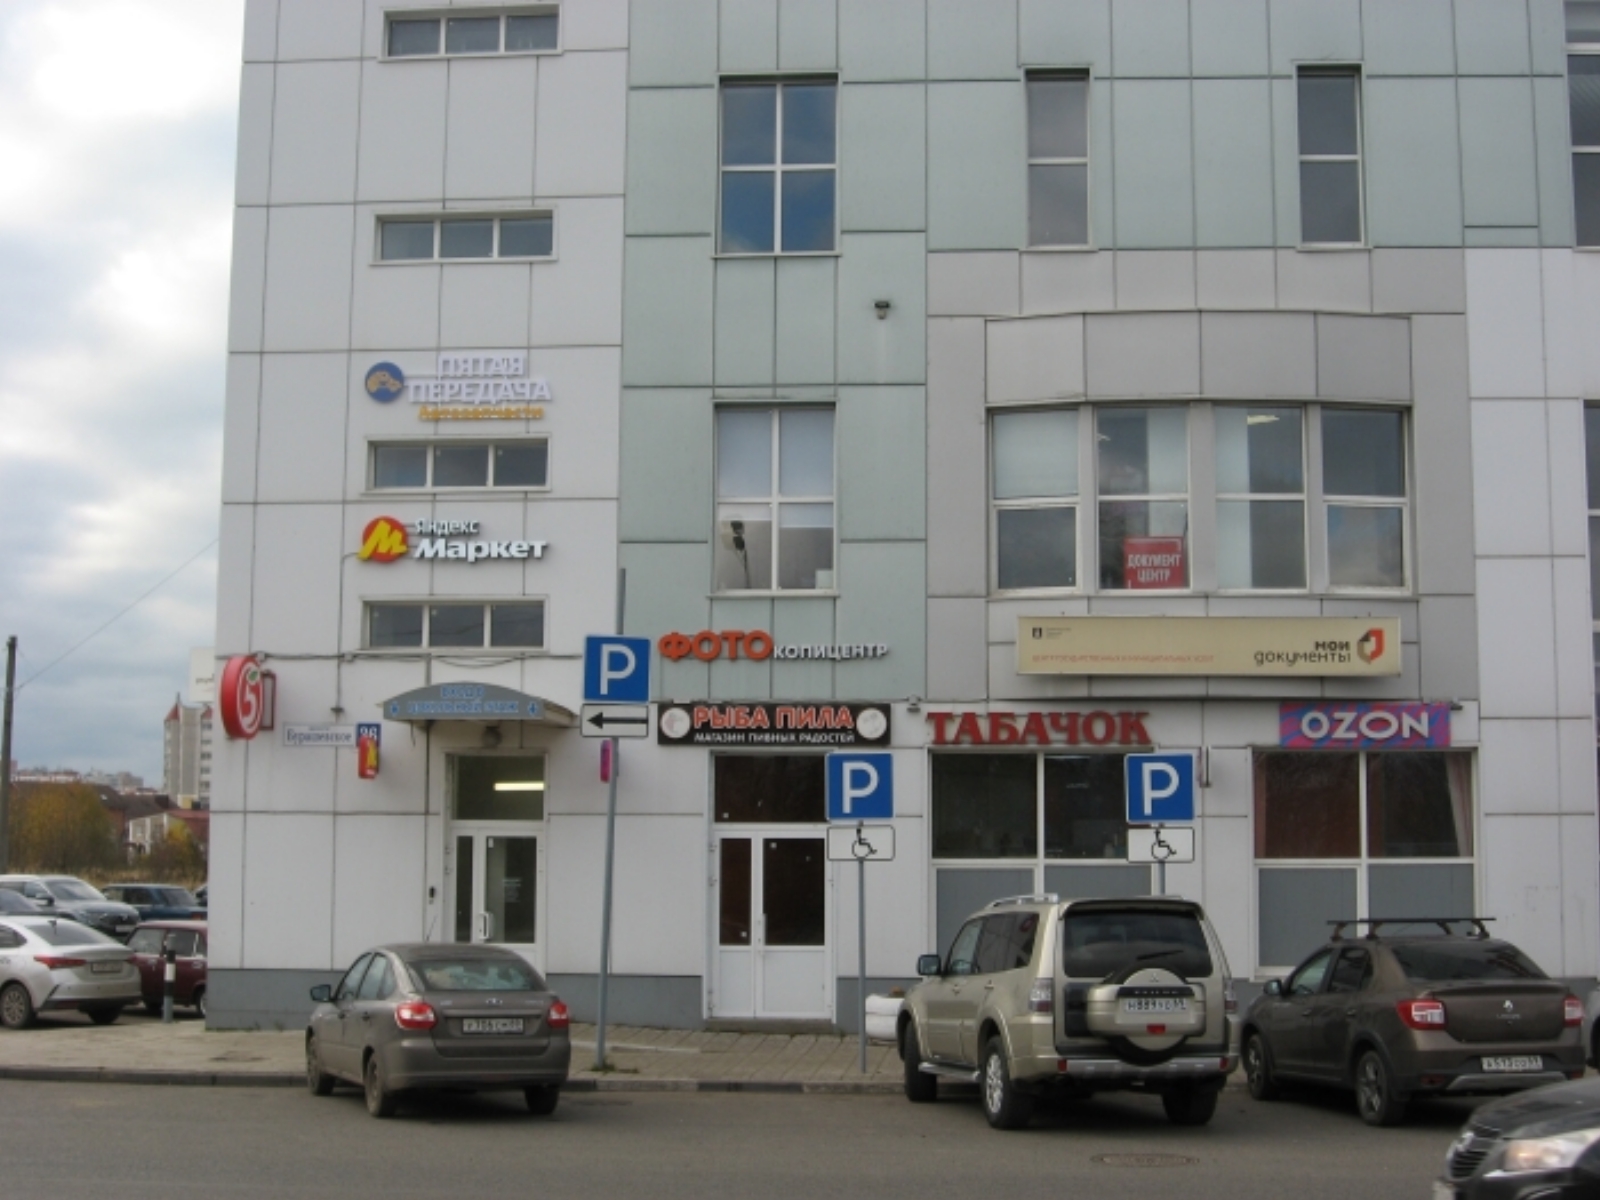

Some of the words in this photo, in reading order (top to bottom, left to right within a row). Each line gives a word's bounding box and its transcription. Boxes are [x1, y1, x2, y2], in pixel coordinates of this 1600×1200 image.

[439, 355, 524, 377] ПЯТАЯ
[408, 379, 552, 404] ПЕРЕДАЧА
[414, 518, 480, 536] Яндекс
[413, 538, 548, 562] Маркет
[1127, 553, 1181, 569] ДОКУМЕНТ
[1137, 568, 1171, 584] ЦЕНТР
[657, 629, 774, 662] ФОТО
[599, 643, 637, 695] P
[1253, 650, 1351, 668] документы
[694, 706, 770, 729] РЫБА
[776, 706, 855, 729] ПИЛА
[926, 711, 1152, 746] ТАБАЧОК
[1301, 710, 1430, 740] OZON
[694, 732, 746, 743] МАГАЗИН
[748, 732, 797, 743] ПИВНЫХ
[799, 731, 855, 743] РАДОСТЕЙ
[842, 760, 880, 814] P
[1141, 762, 1180, 816] P
